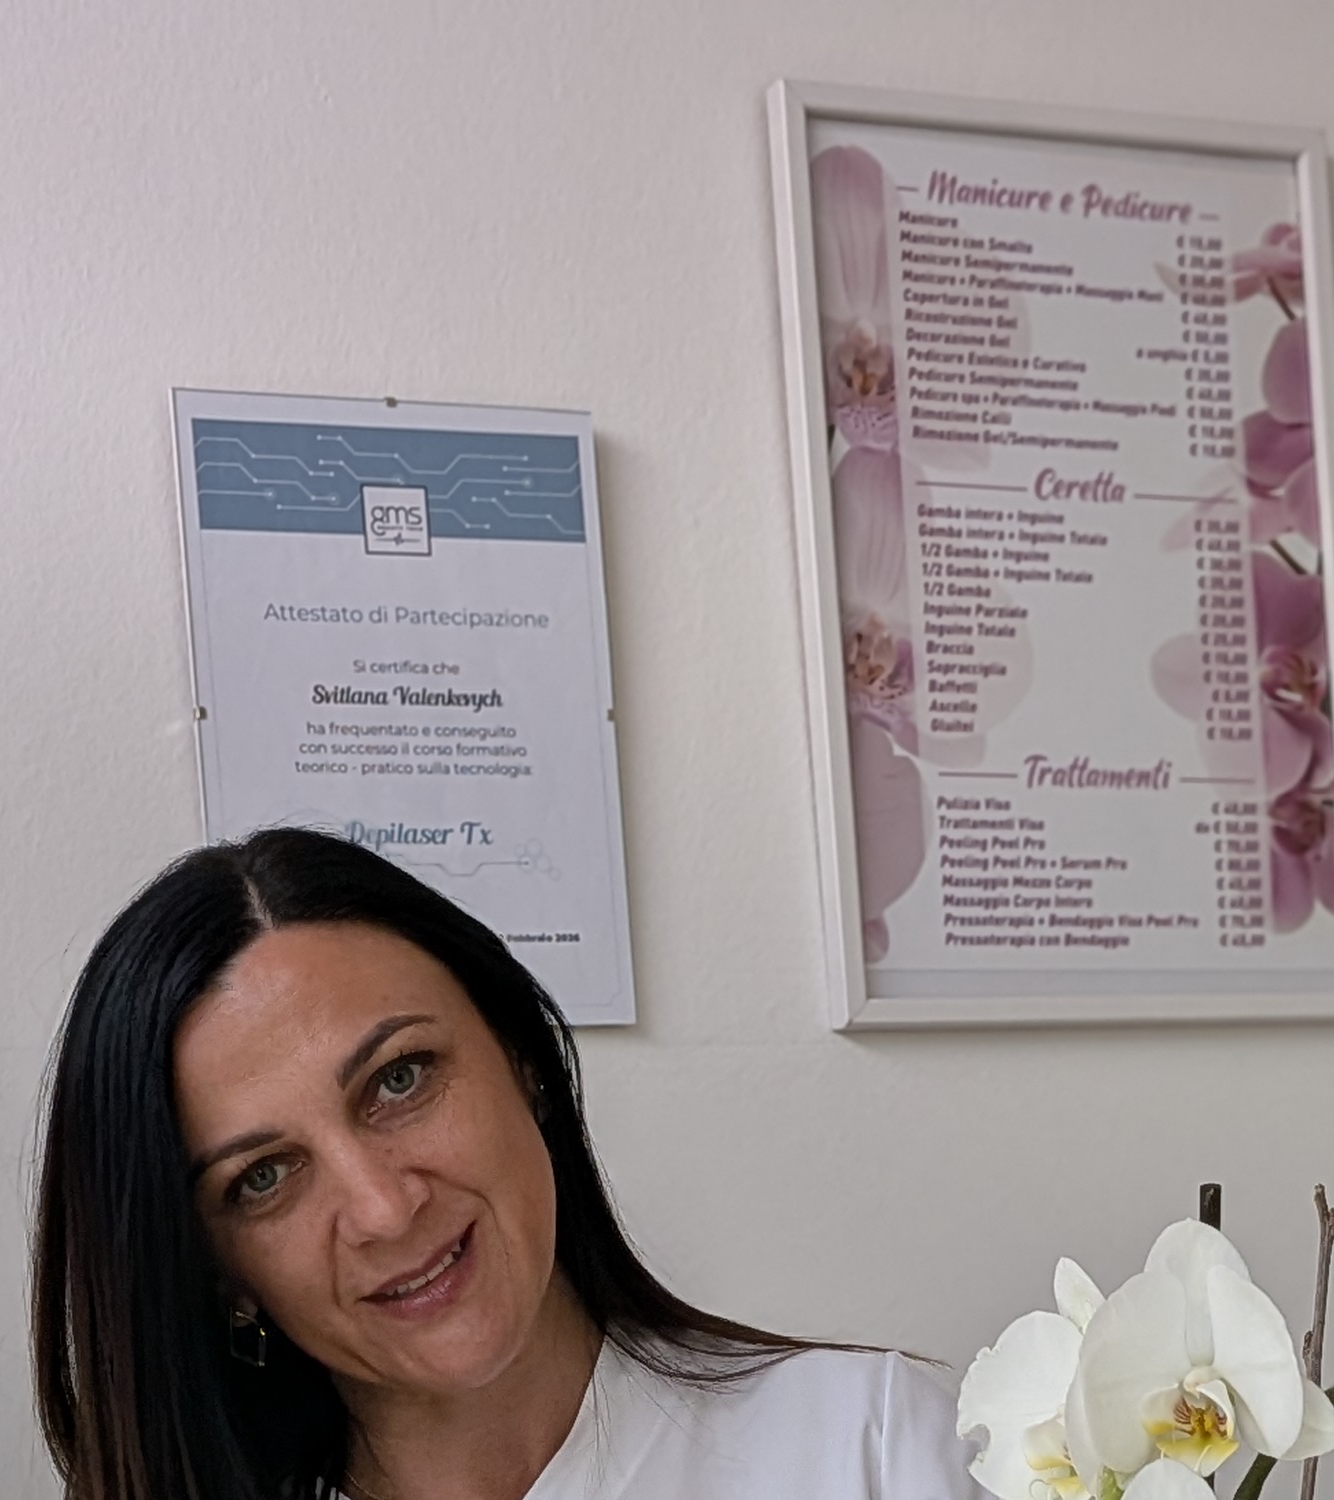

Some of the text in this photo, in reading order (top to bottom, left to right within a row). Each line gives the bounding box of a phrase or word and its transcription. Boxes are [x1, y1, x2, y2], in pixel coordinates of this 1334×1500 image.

[928, 170, 1192, 225] Manicure e Pedicure
[1034, 467, 1126, 503] Ceretta
[370, 505, 423, 537] gms
[264, 603, 549, 629] Attestato di Partecipazione
[353, 659, 460, 675] Si certifica che
[312, 684, 389, 706] Svitlana
[306, 721, 516, 742] ha frequentato e conseguito
[298, 742, 527, 758] con successo il corso formativo
[295, 760, 348, 773] teorico
[361, 762, 413, 777] pratico
[417, 762, 450, 775] sulla
[1024, 754, 1172, 790] Trattamenti
[460, 821, 494, 846] Tx
